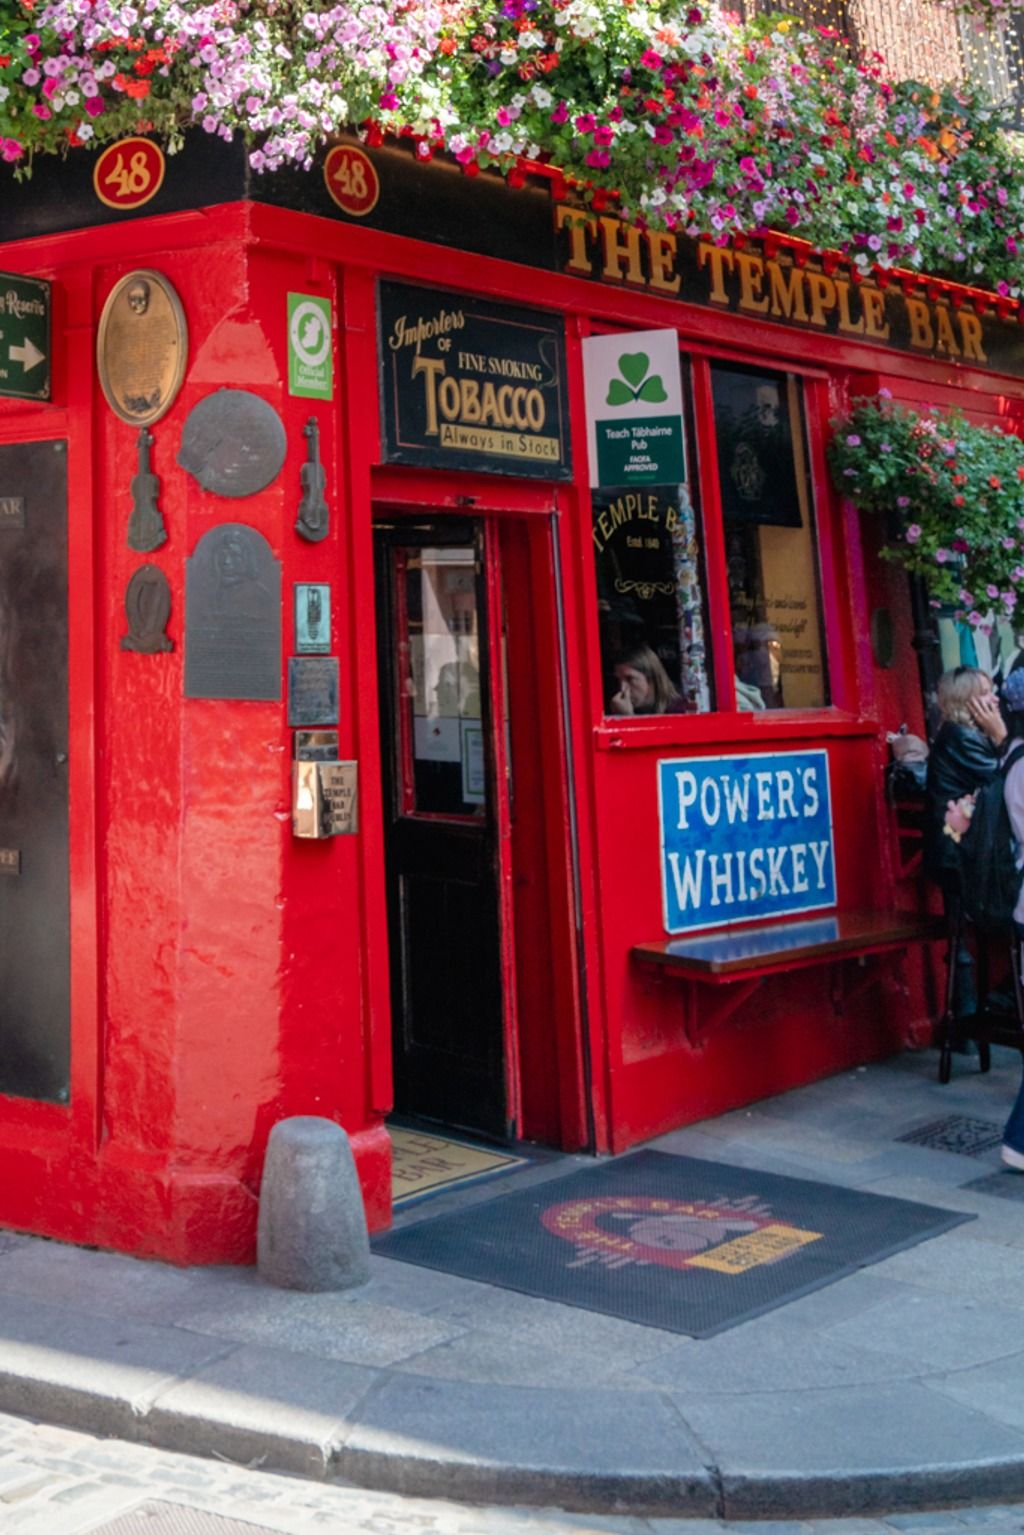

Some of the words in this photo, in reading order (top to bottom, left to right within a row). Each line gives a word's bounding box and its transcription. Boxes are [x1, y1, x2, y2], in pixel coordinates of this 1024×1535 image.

[105, 150, 152, 197] 48
[332, 156, 368, 199] 48
[556, 205, 681, 294] THE
[700, 242, 890, 341] TEMPLE
[906, 298, 989, 363] BAR
[6, 289, 45, 319] Reserve
[388, 310, 465, 355] Importers
[437, 338, 452, 352] OF
[458, 351, 486, 373] FINE
[488, 356, 543, 382] SMOKING
[411, 355, 546, 436] TOBACCO
[442, 426, 495, 449] Always
[500, 436, 514, 452] in
[518, 435, 559, 458] Stock
[605, 428, 630, 439] Teach
[631, 426, 673, 438] Tábhairne
[631, 439, 648, 451] Pub
[623, 463, 658, 473] APPROVED
[591, 492, 660, 553] TEMPLE
[674, 766, 820, 831] POWER'S
[667, 840, 830, 912] WHISKEY
[393, 1156, 466, 1182] BAR
